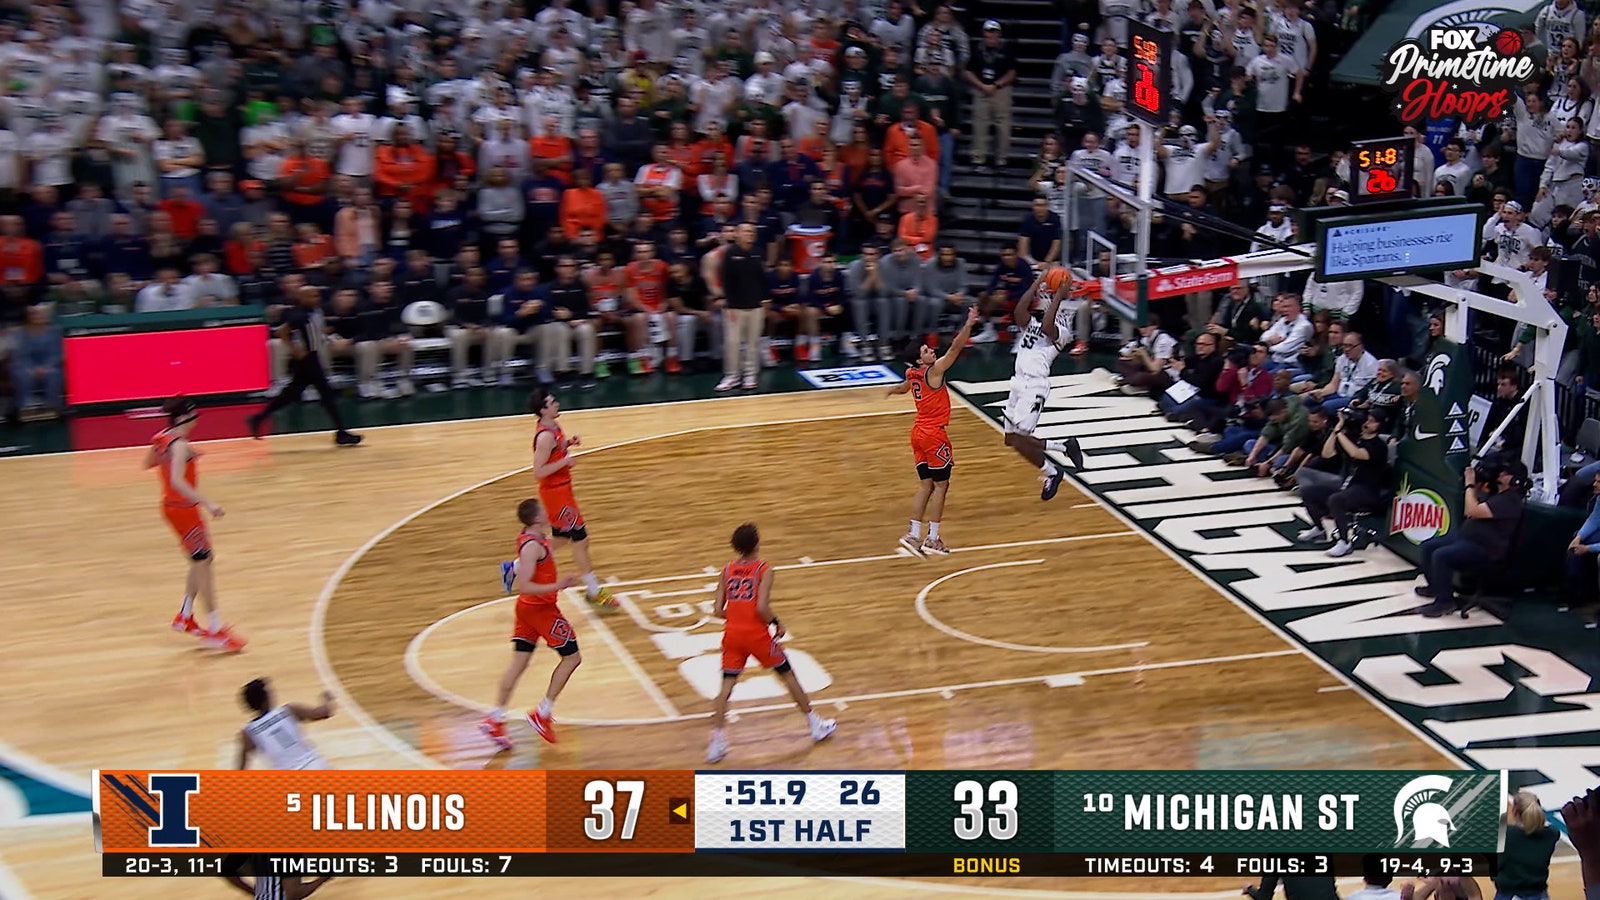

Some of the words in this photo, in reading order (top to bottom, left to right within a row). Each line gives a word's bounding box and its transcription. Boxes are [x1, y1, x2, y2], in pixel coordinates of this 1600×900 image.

[1332, 238, 1375, 254] Helping
[1377, 234, 1434, 249] businesses
[1436, 231, 1453, 243] rise
[1331, 253, 1349, 267] like
[1352, 251, 1402, 267] Spartans.
[912, 381, 922, 400] 2
